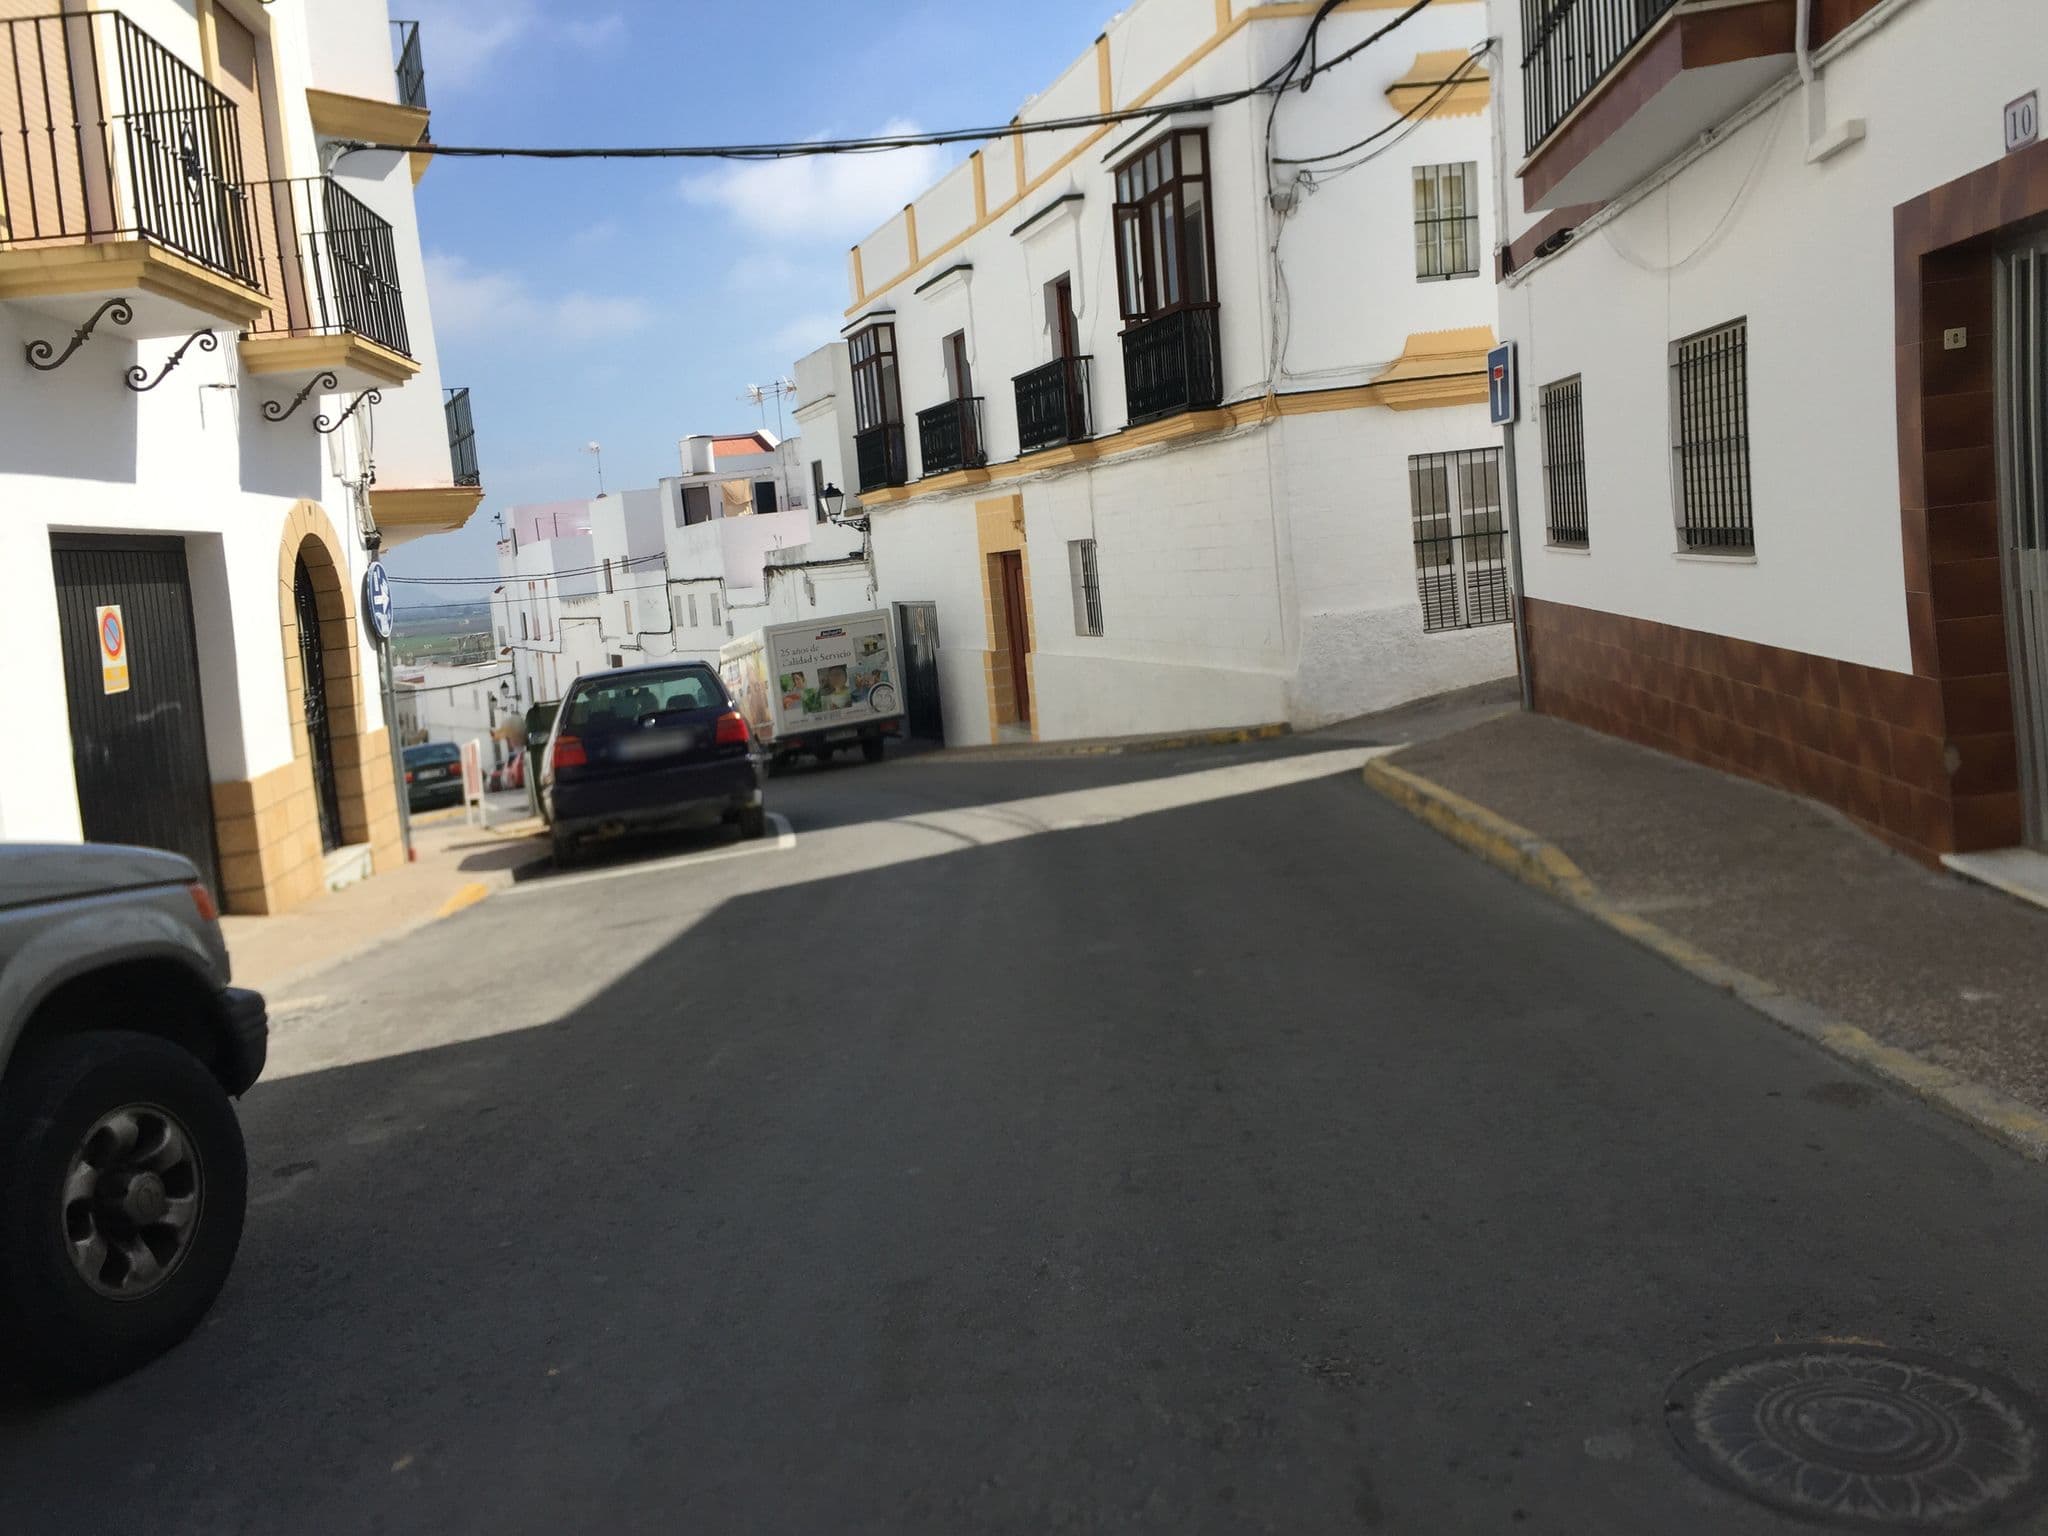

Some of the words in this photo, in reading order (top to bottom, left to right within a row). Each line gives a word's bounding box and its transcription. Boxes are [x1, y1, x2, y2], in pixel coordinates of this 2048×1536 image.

[2011, 104, 2032, 141] 10
[780, 648, 790, 657] 25
[820, 650, 852, 661] Servicio
